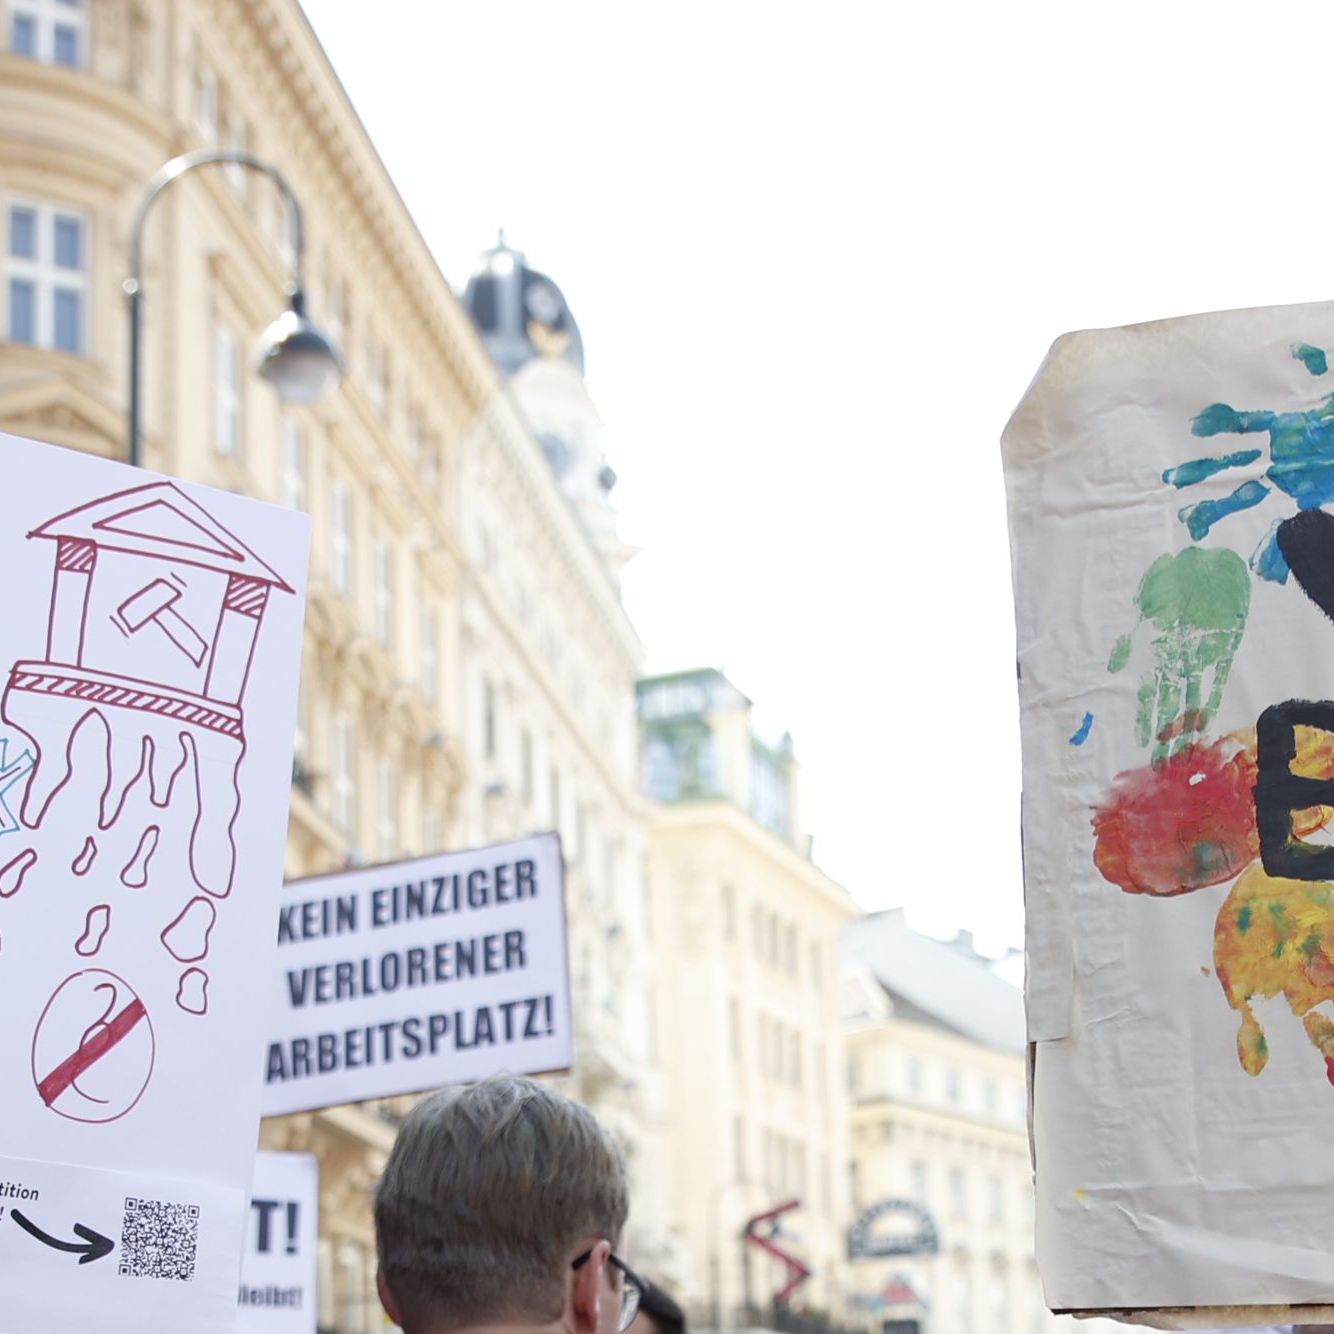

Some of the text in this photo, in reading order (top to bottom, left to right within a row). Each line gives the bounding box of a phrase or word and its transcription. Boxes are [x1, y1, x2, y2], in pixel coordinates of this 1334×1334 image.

[278, 859, 538, 946] KEIN EINZIGER
[287, 930, 527, 1008] VERLORENER
[265, 994, 555, 1085] ARBEITSPLATZ!
